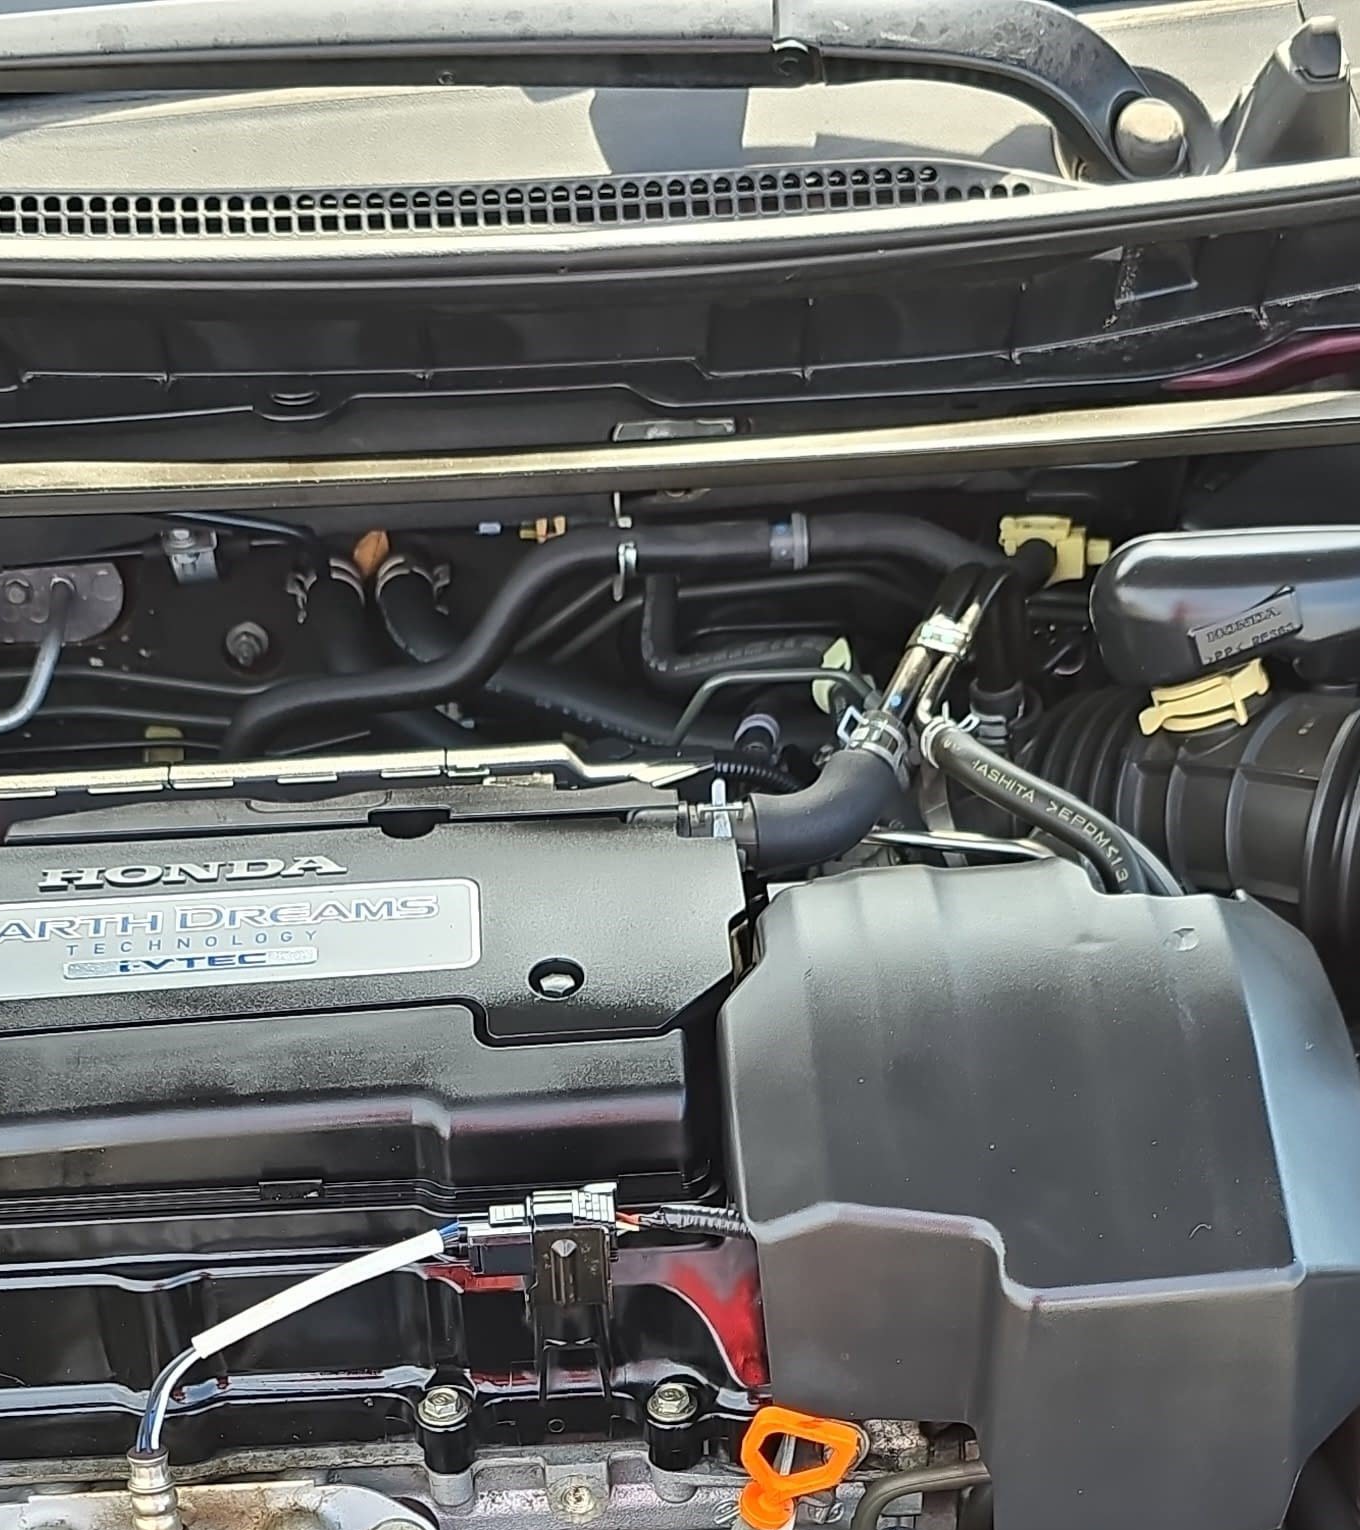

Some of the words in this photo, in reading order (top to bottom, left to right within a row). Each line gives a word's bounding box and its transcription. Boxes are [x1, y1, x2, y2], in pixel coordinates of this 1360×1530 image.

[38, 854, 348, 892] HONDA
[174, 894, 441, 932] DREAMS
[65, 929, 321, 957] TECHNOLOGY
